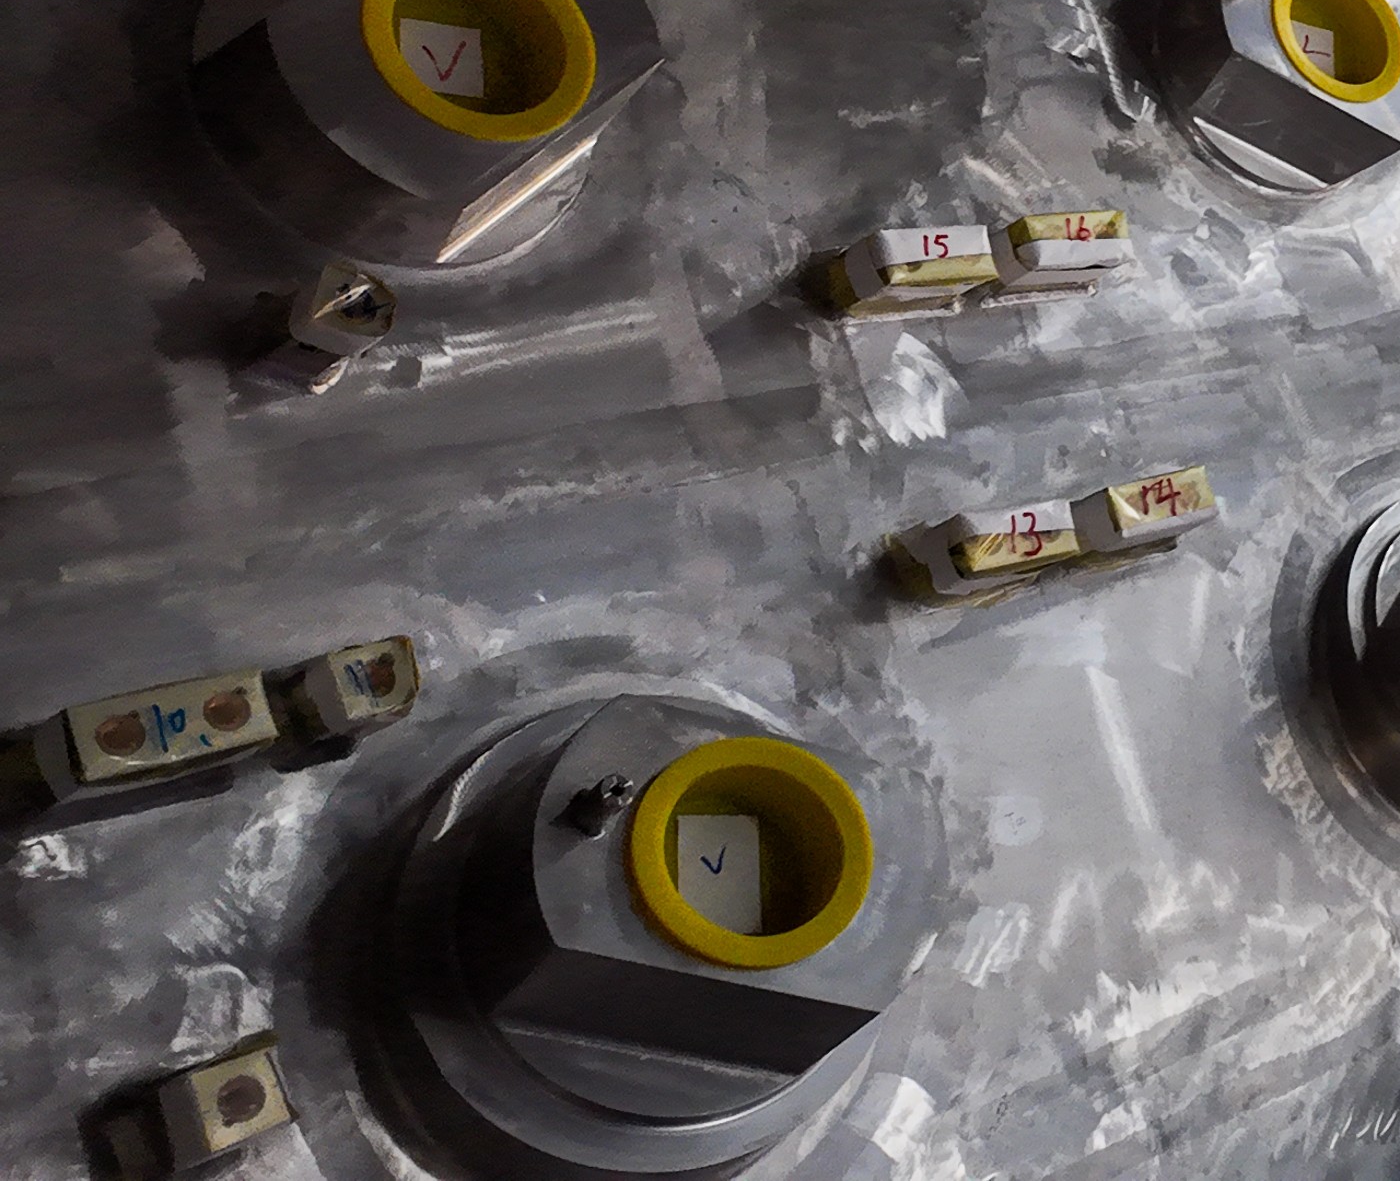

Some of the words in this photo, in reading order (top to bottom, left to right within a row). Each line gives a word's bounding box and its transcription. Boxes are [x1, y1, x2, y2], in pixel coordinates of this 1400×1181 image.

[1065, 215, 1092, 242] 16
[922, 234, 949, 259] 15
[1140, 477, 1182, 517] 14
[1009, 511, 1043, 556] 13
